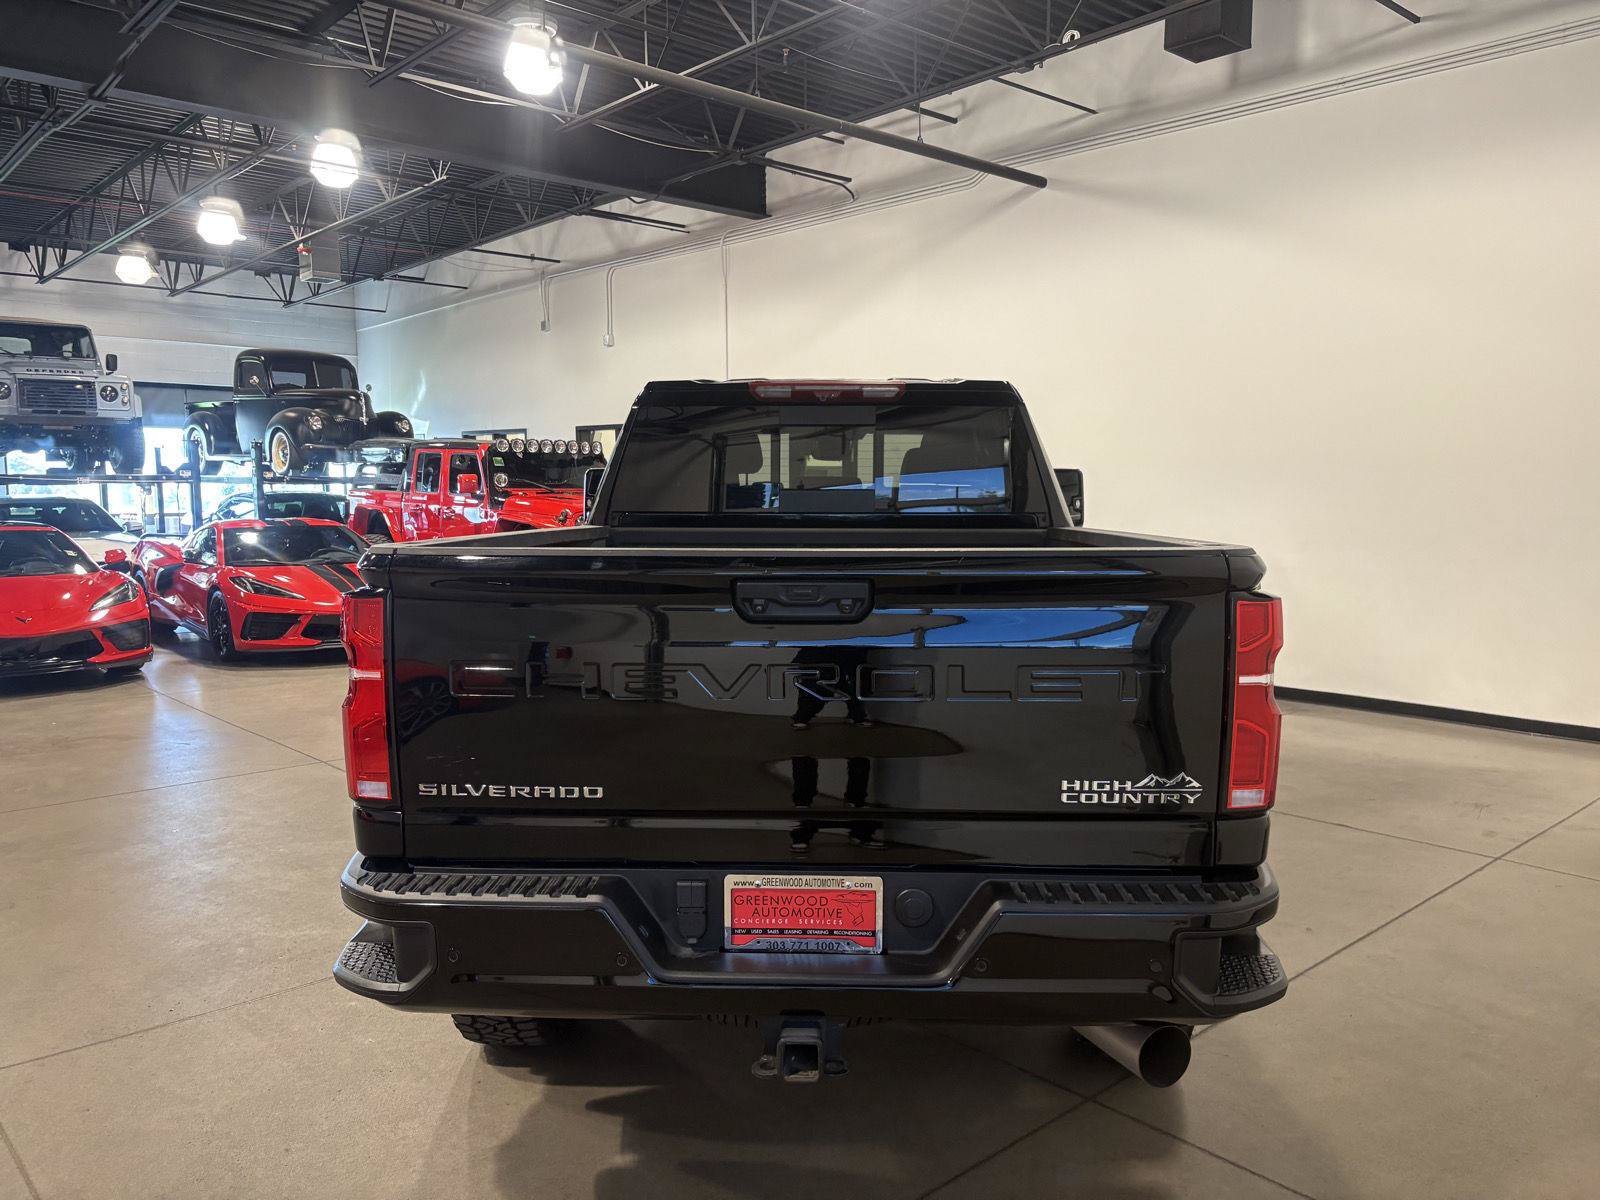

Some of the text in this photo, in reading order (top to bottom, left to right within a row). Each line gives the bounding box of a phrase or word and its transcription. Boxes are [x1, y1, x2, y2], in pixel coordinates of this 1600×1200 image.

[450, 659, 1166, 702] CHEVROLET
[418, 782, 604, 798] SILVERADO
[1060, 779, 1132, 791] HIGH
[1060, 792, 1202, 804] COUNTRY
[761, 877, 803, 887] GREENWOOD
[804, 877, 845, 888] AUTOMOTIVE
[733, 895, 829, 906] GREENWOOD
[751, 907, 843, 918] AUTOMOTIVE
